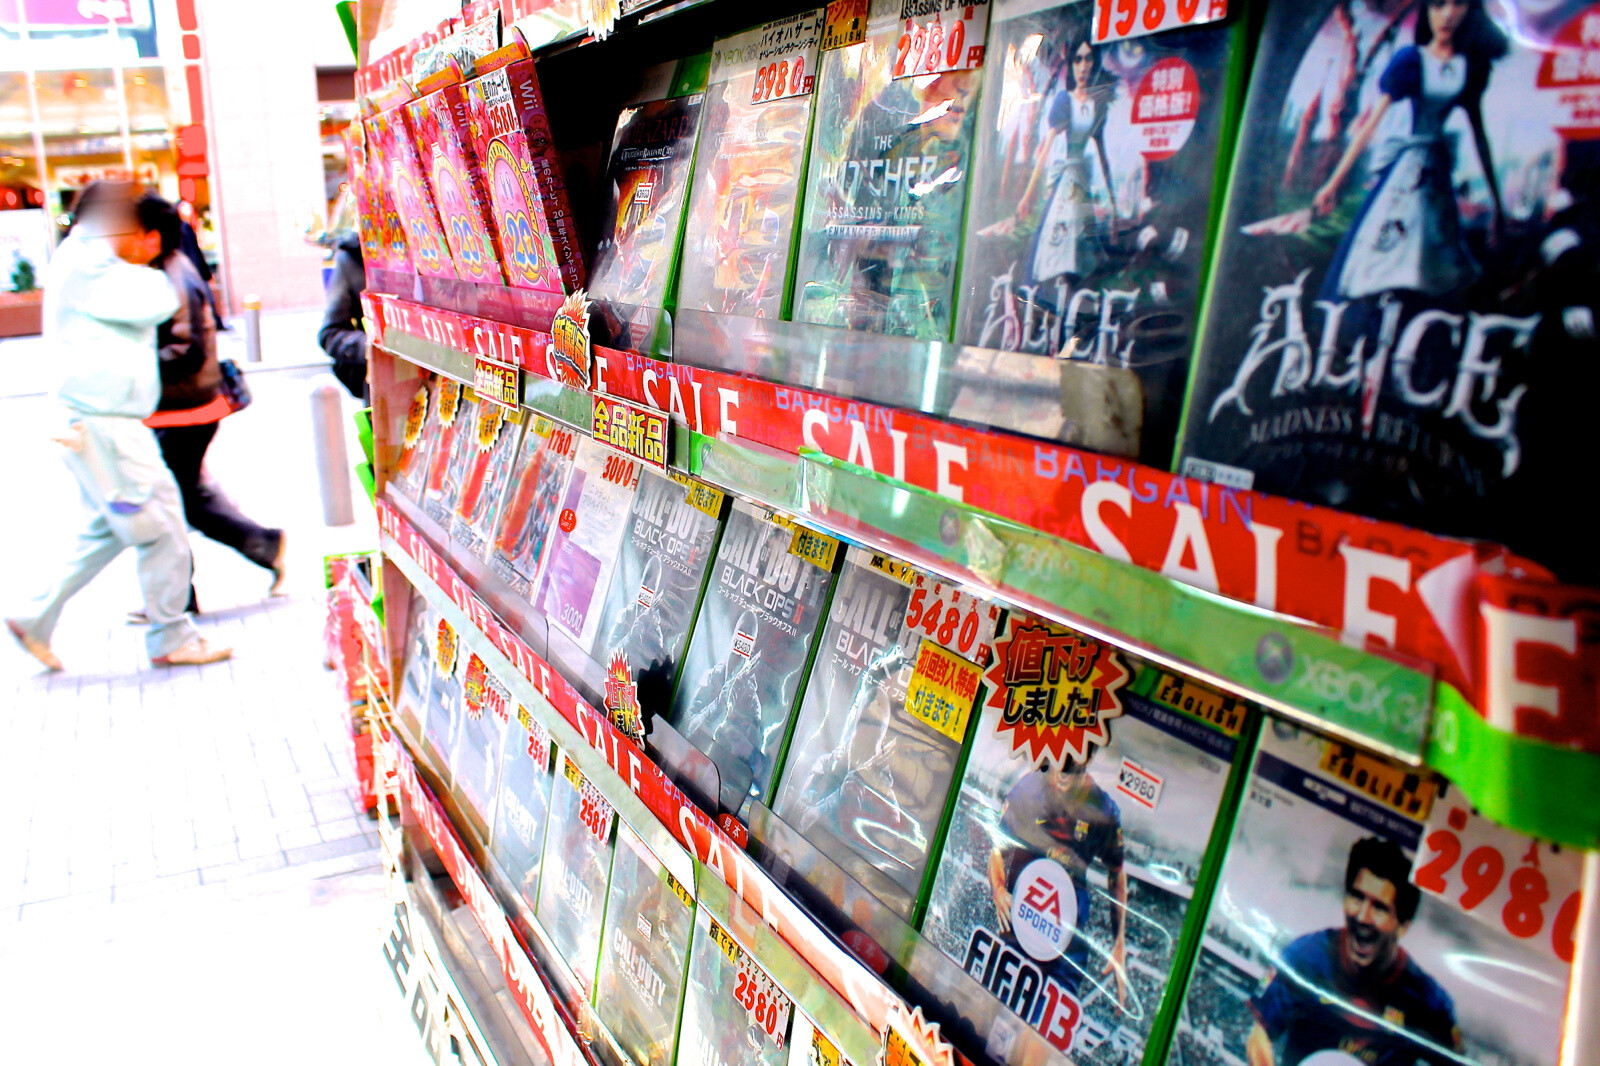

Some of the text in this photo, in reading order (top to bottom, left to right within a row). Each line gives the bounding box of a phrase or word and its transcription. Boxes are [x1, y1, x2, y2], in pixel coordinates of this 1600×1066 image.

[760, 18, 823, 48] バイオハザード
[899, 0, 941, 20] ASSASSINS
[822, 29, 862, 49] ENGLISH
[453, 100, 469, 128] Wii
[519, 79, 539, 111] Wii
[873, 134, 893, 150] THE
[826, 205, 882, 220] ASSASSINS
[893, 205, 925, 220] KINGS
[827, 226, 877, 238] ENHANCED
[978, 260, 1142, 370] ALICE
[473, 326, 521, 366] SALE
[1207, 268, 1544, 479] ALICE
[642, 368, 740, 436] SALE
[774, 386, 894, 436] BARGAIN
[1249, 405, 1353, 443] MADNESS
[593, 400, 665, 465] 全品新品
[802, 408, 969, 502] SALE
[1034, 444, 1255, 531] BARGAIN
[633, 519, 665, 550] BLACK
[666, 537, 690, 565] OPS
[718, 516, 765, 577] CALL
[1080, 480, 1413, 651] SALE
[720, 565, 765, 604] BLACK
[764, 588, 795, 619] OPS
[831, 580, 896, 648] CALL
[560, 607, 583, 633] 3000
[906, 588, 992, 667] 5480円
[499, 630, 551, 699] SALE
[916, 646, 980, 702] 初回封入特典
[1006, 628, 1098, 683] 値下げ
[914, 685, 963, 733] 付きます!
[1003, 686, 1101, 727] しました!
[1160, 685, 1239, 731] ENGLISH
[1297, 652, 1391, 722] XBOX
[575, 702, 642, 796] SALE
[1119, 768, 1156, 802] ¥2980
[579, 798, 607, 842] 2580
[722, 816, 742, 839] 見本
[1017, 903, 1062, 945] SPORTS
[1022, 876, 1062, 925] EA
[613, 926, 636, 973] CALL
[734, 972, 785, 1052] 2580円
[963, 928, 1081, 1052] FIFA 13
